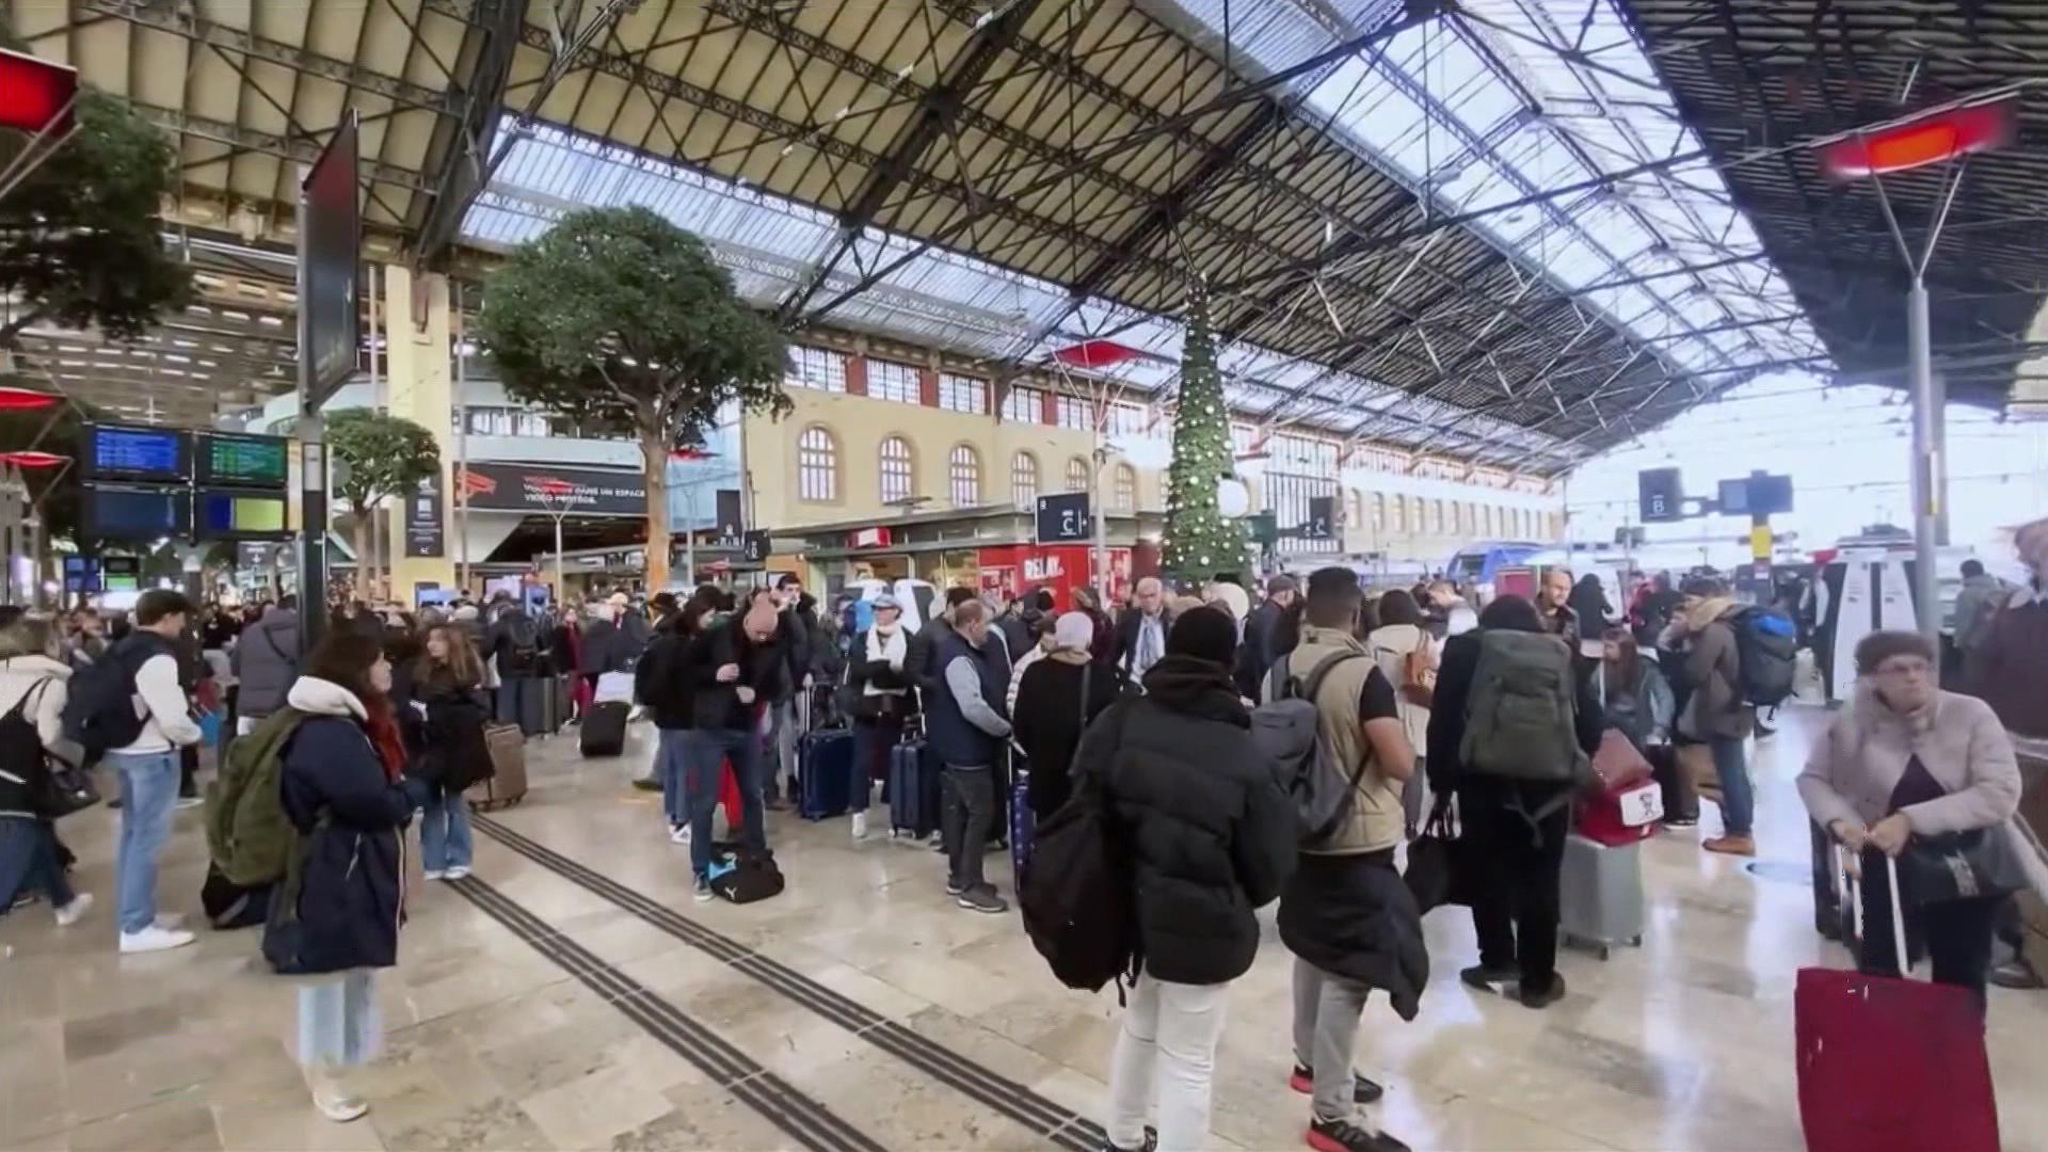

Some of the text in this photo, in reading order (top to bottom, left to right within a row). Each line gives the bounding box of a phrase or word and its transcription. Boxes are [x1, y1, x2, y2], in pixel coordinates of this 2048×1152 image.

[615, 489, 645, 497] ESPACE
[1653, 499, 1664, 513] B
[1063, 517, 1074, 533] C
[1024, 556, 1060, 580] RELAY
